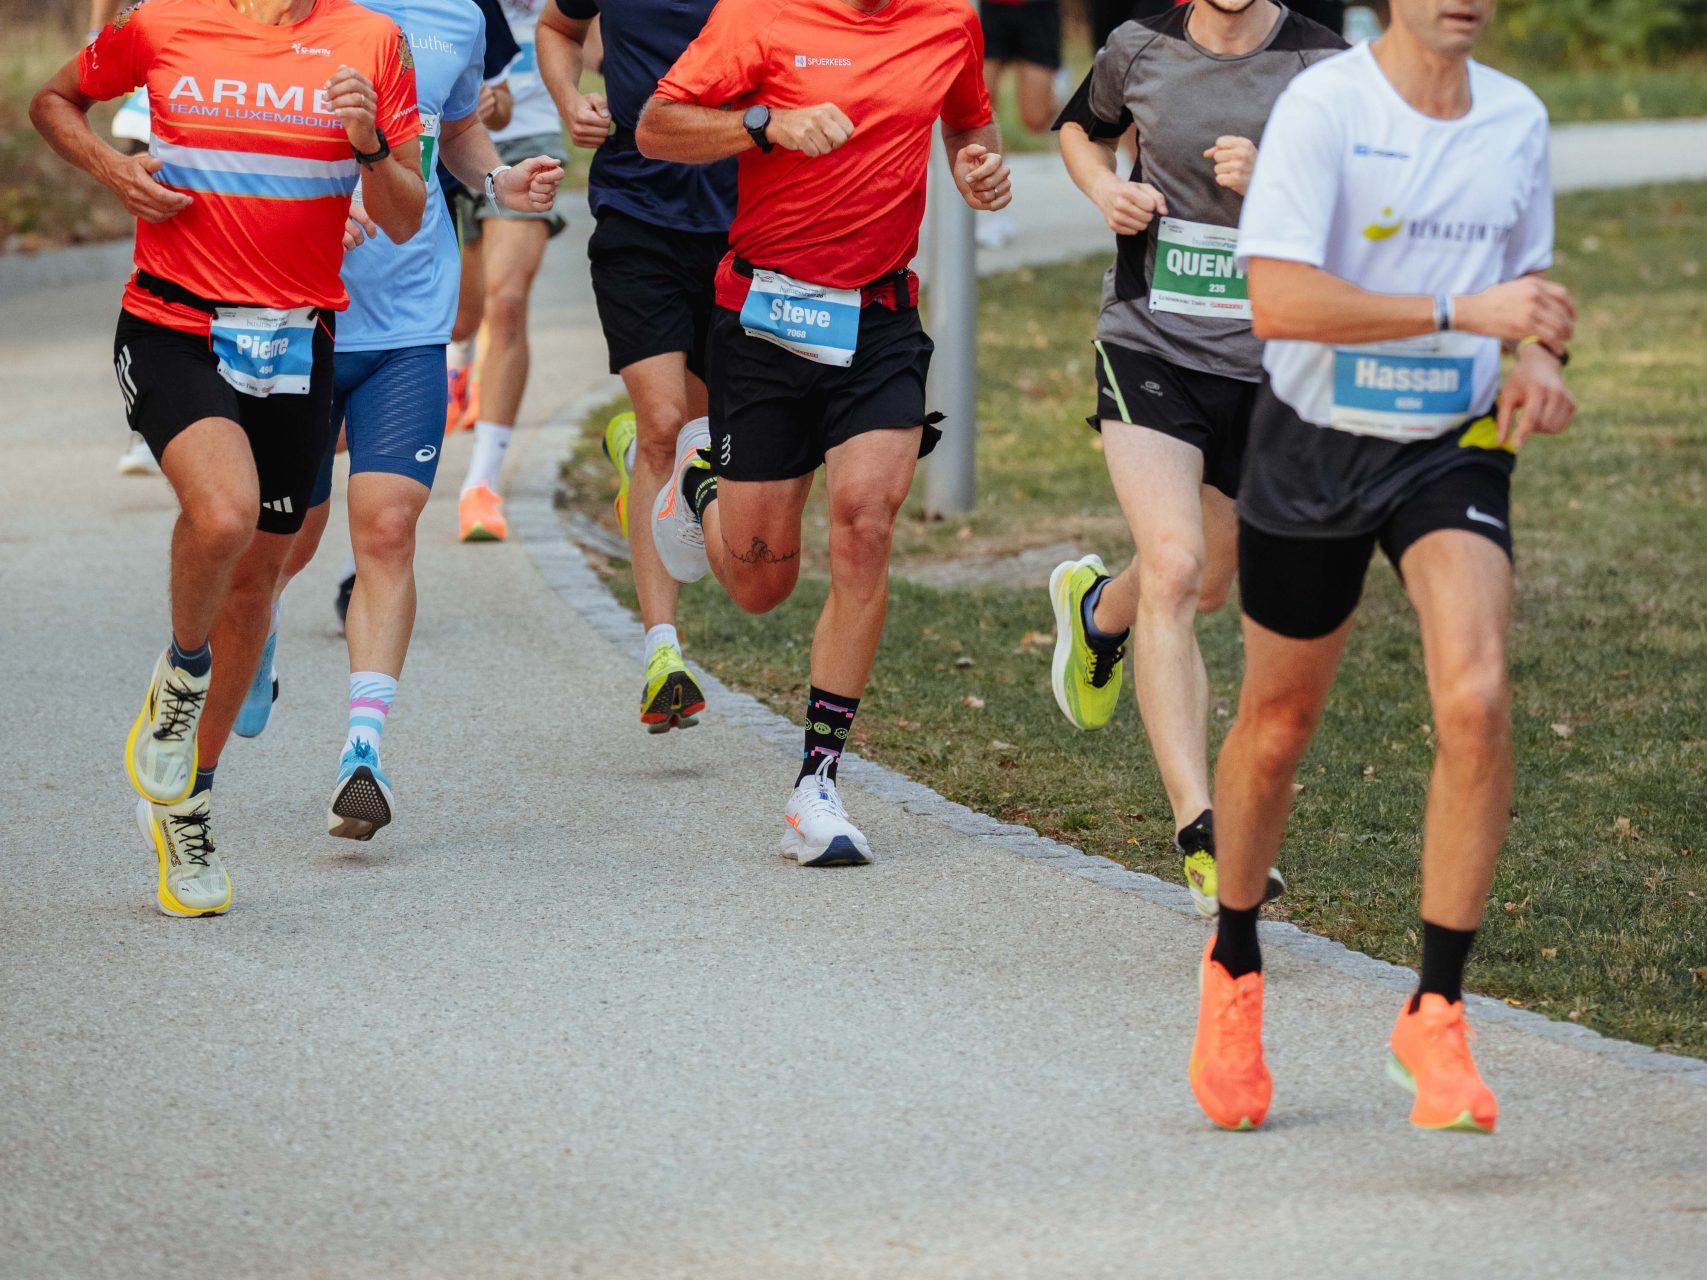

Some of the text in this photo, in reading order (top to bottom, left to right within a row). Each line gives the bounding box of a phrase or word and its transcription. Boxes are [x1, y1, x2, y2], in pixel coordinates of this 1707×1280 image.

[410, 32, 457, 55] Luther.
[807, 57, 852, 66] SPUERKEESS
[168, 103, 344, 129] TEAM LUXEMBOUR
[1208, 283, 1226, 293] 235
[769, 298, 831, 328] Steve
[786, 328, 807, 339] 7068
[236, 334, 289, 360] Pierre
[1354, 358, 1460, 393] Hassan
